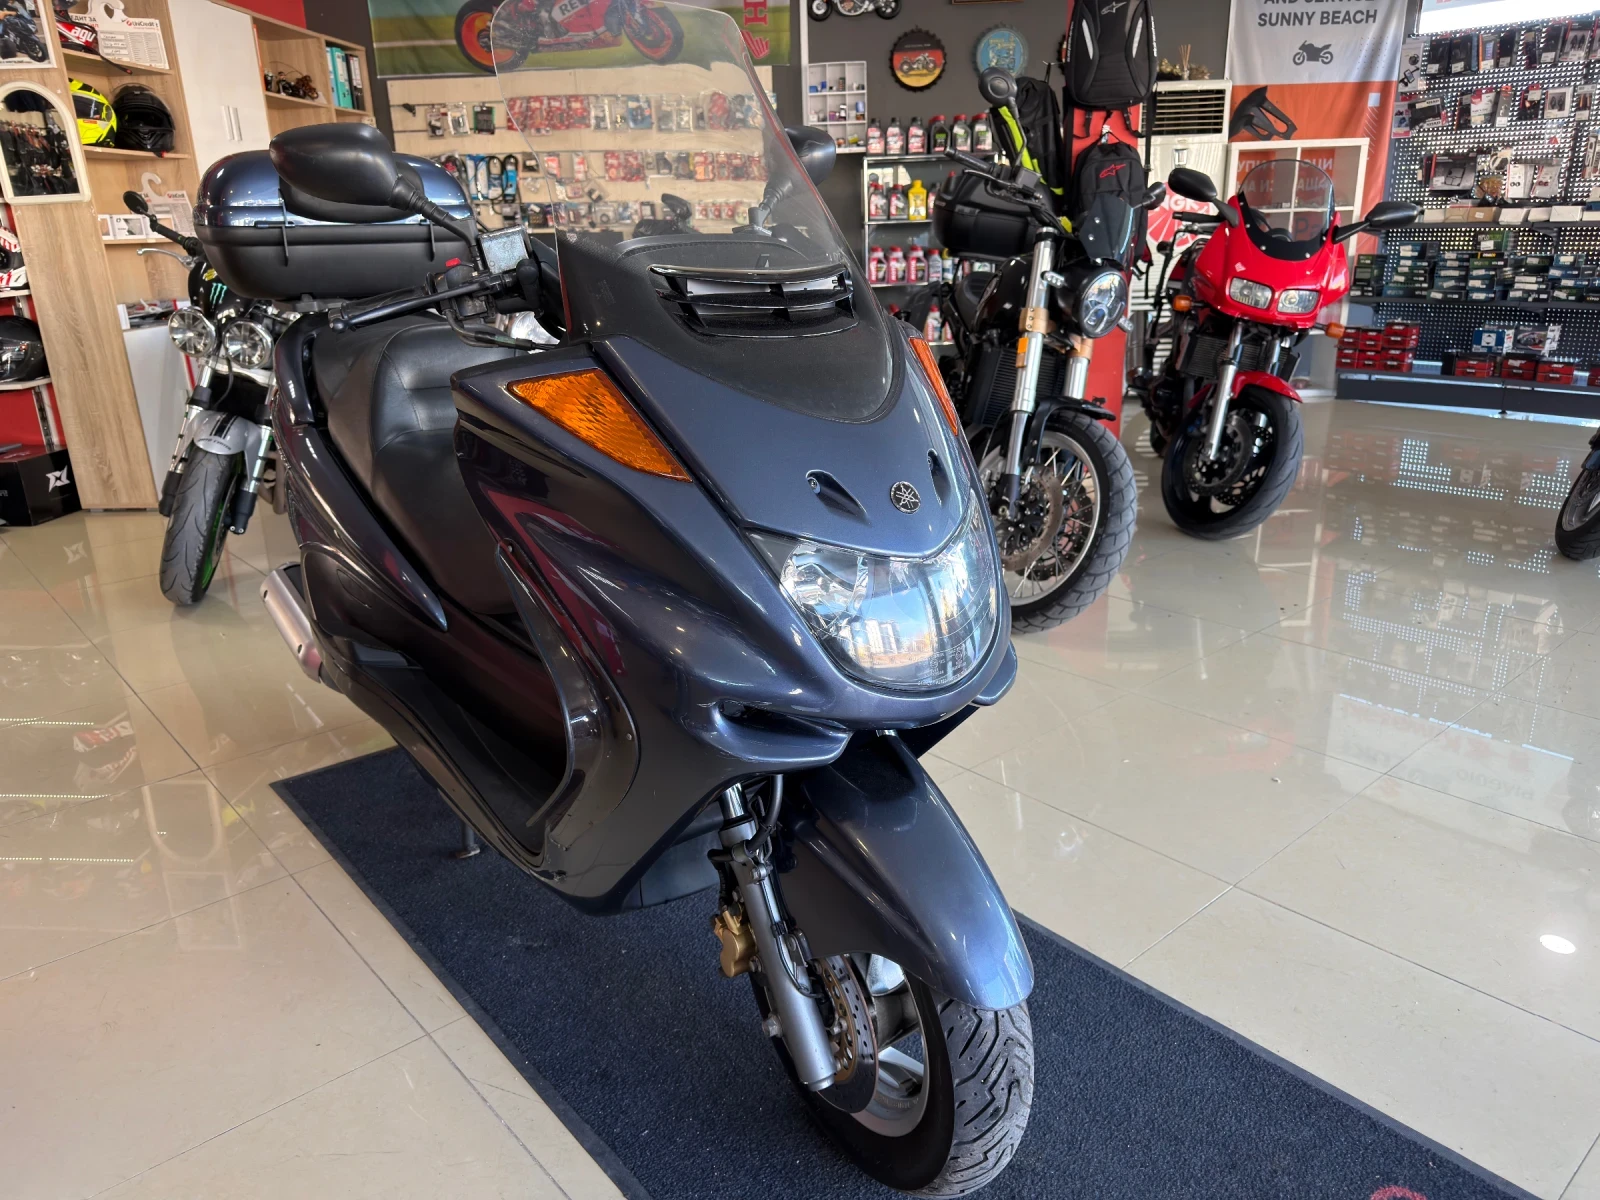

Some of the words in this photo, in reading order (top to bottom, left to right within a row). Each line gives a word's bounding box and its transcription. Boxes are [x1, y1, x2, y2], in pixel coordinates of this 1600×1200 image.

[1257, 11, 1316, 27] SUNNY
[1319, 9, 1378, 25] BEACH
[71, 26, 97, 43] agv
